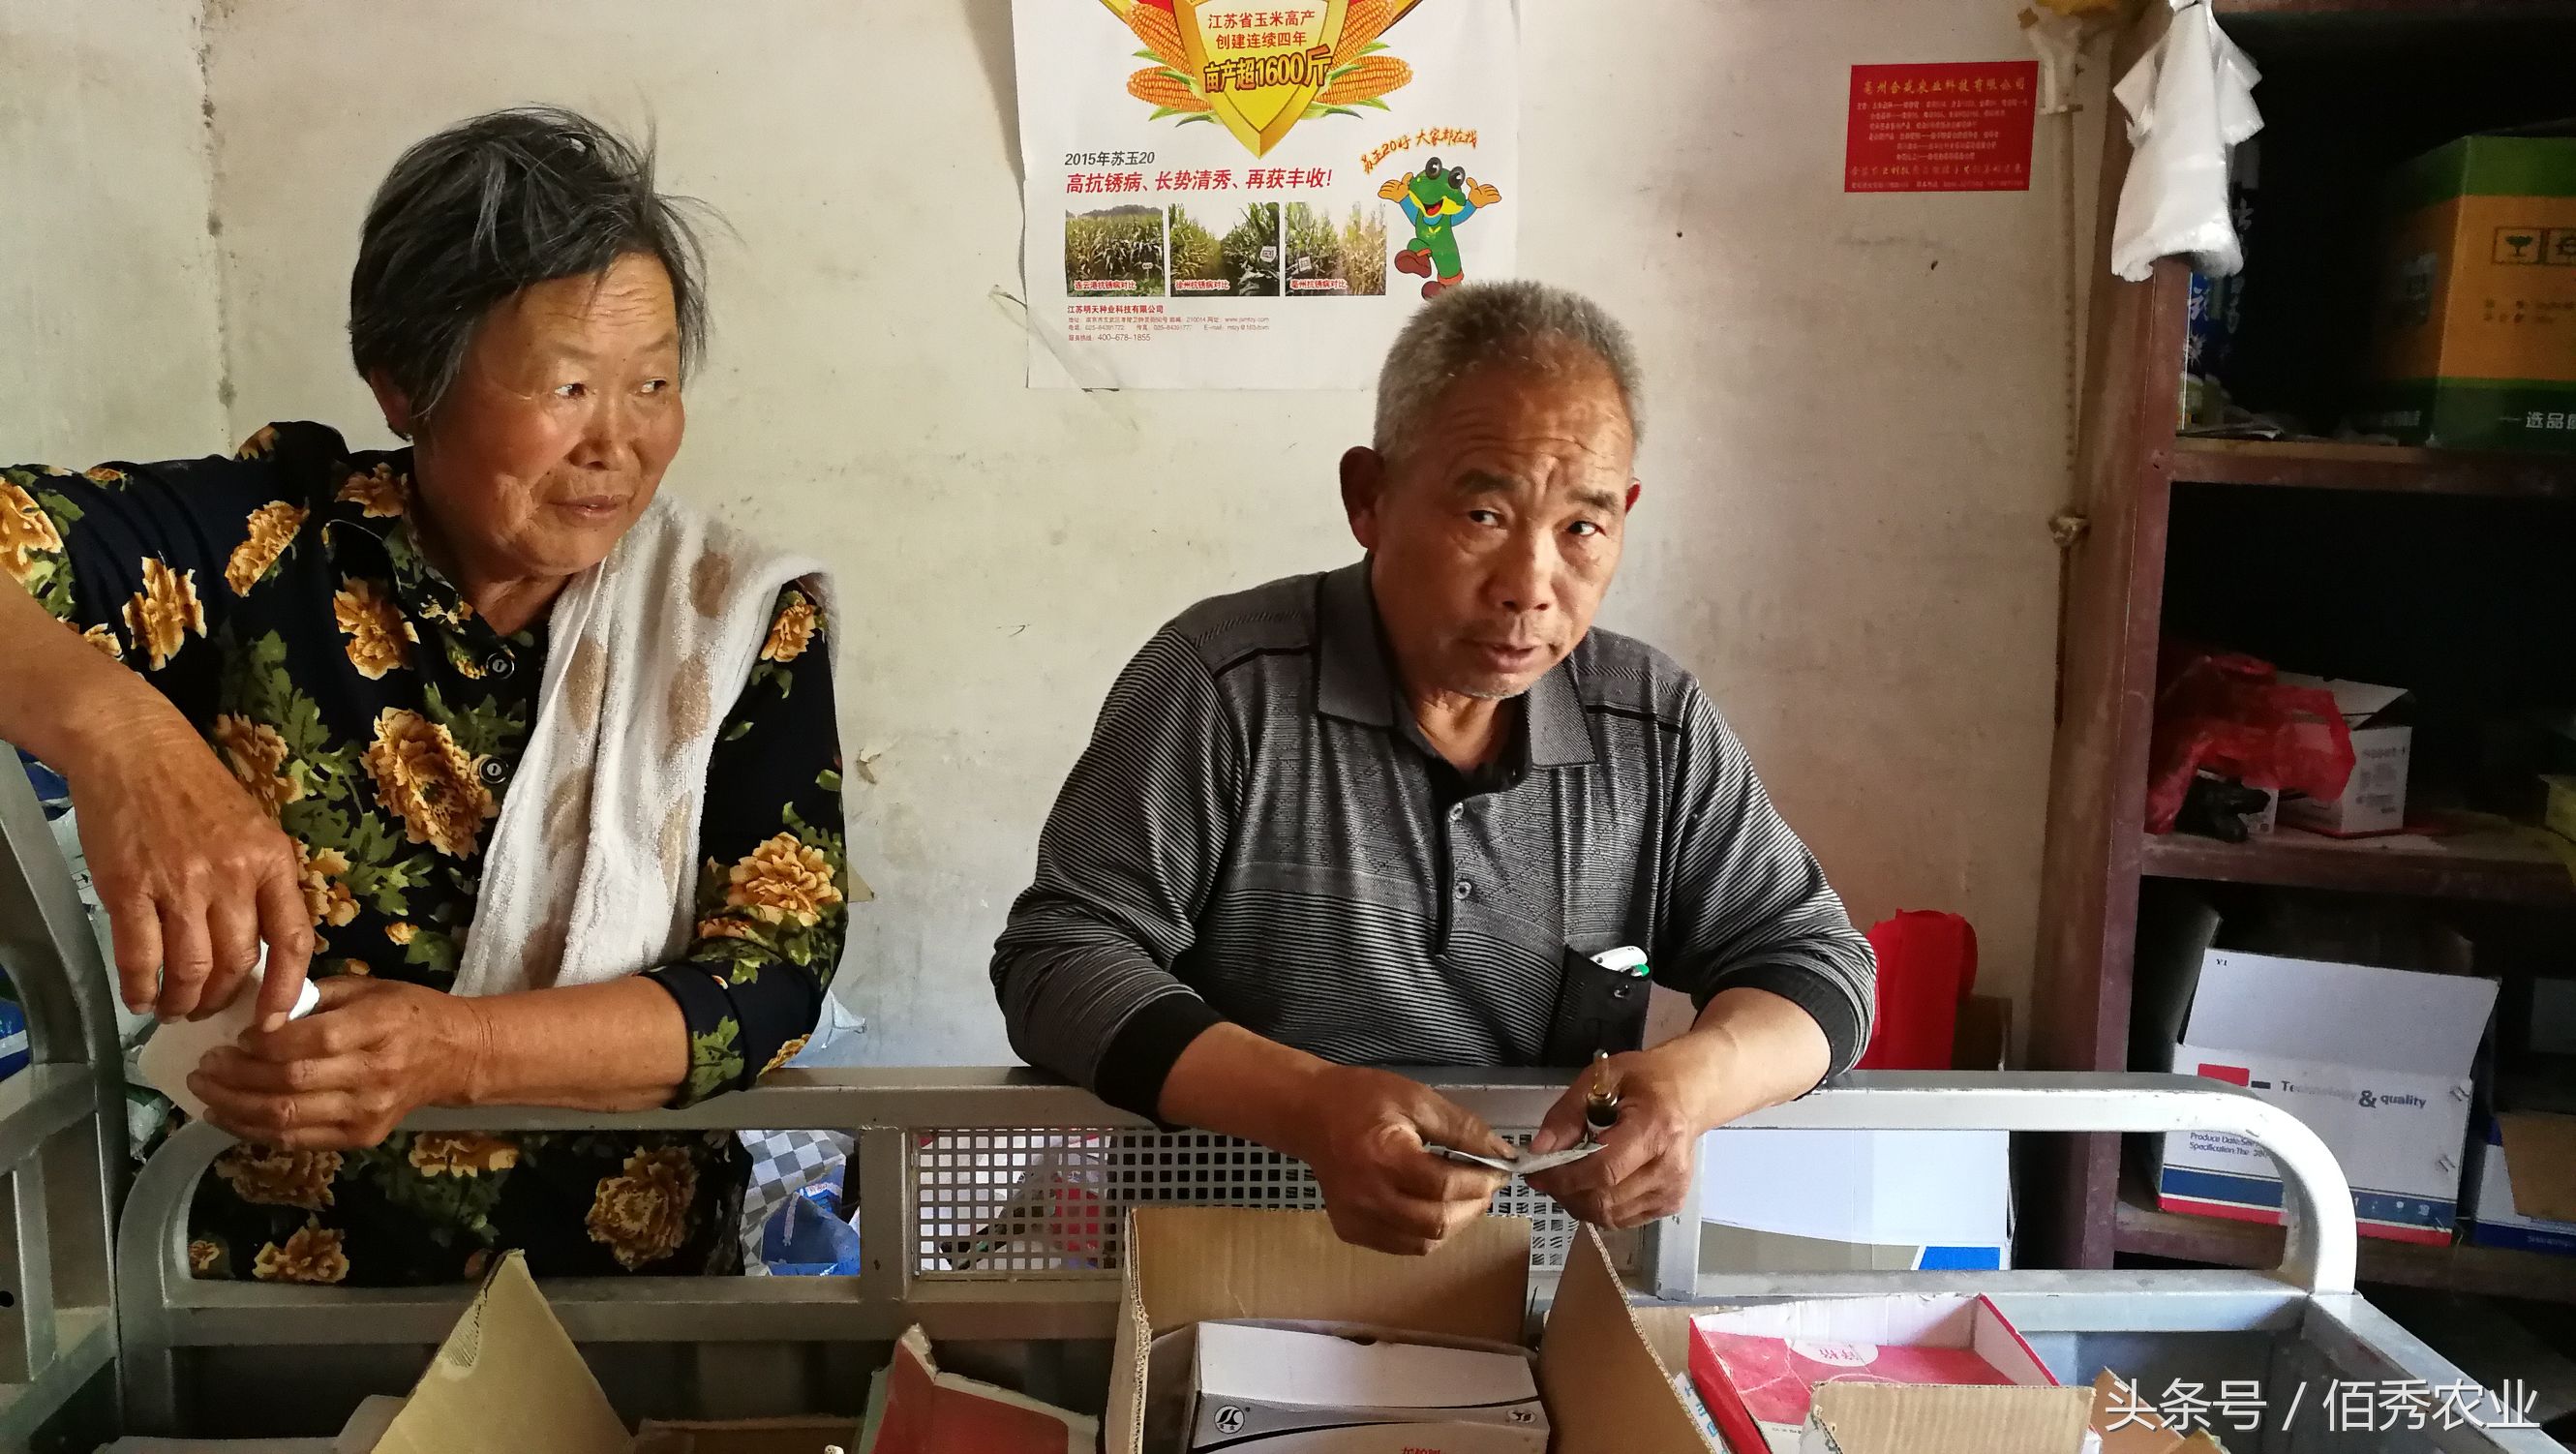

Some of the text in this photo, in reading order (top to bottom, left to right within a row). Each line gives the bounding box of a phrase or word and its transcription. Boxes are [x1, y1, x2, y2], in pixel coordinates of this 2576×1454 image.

[1208, 10, 1316, 29] 江苏省玉米高产
[1216, 30, 1307, 49] 创建连续四年
[1203, 44, 1333, 93] 亩产超1600斤
[1065, 151, 1155, 166] 2015年苏玉20
[1067, 305, 1164, 314] 江苏明天种业科技有限公司
[2358, 1089, 2378, 1108] &
[2380, 1094, 2427, 1108] quality
[2190, 1132, 2221, 1143] Produce
